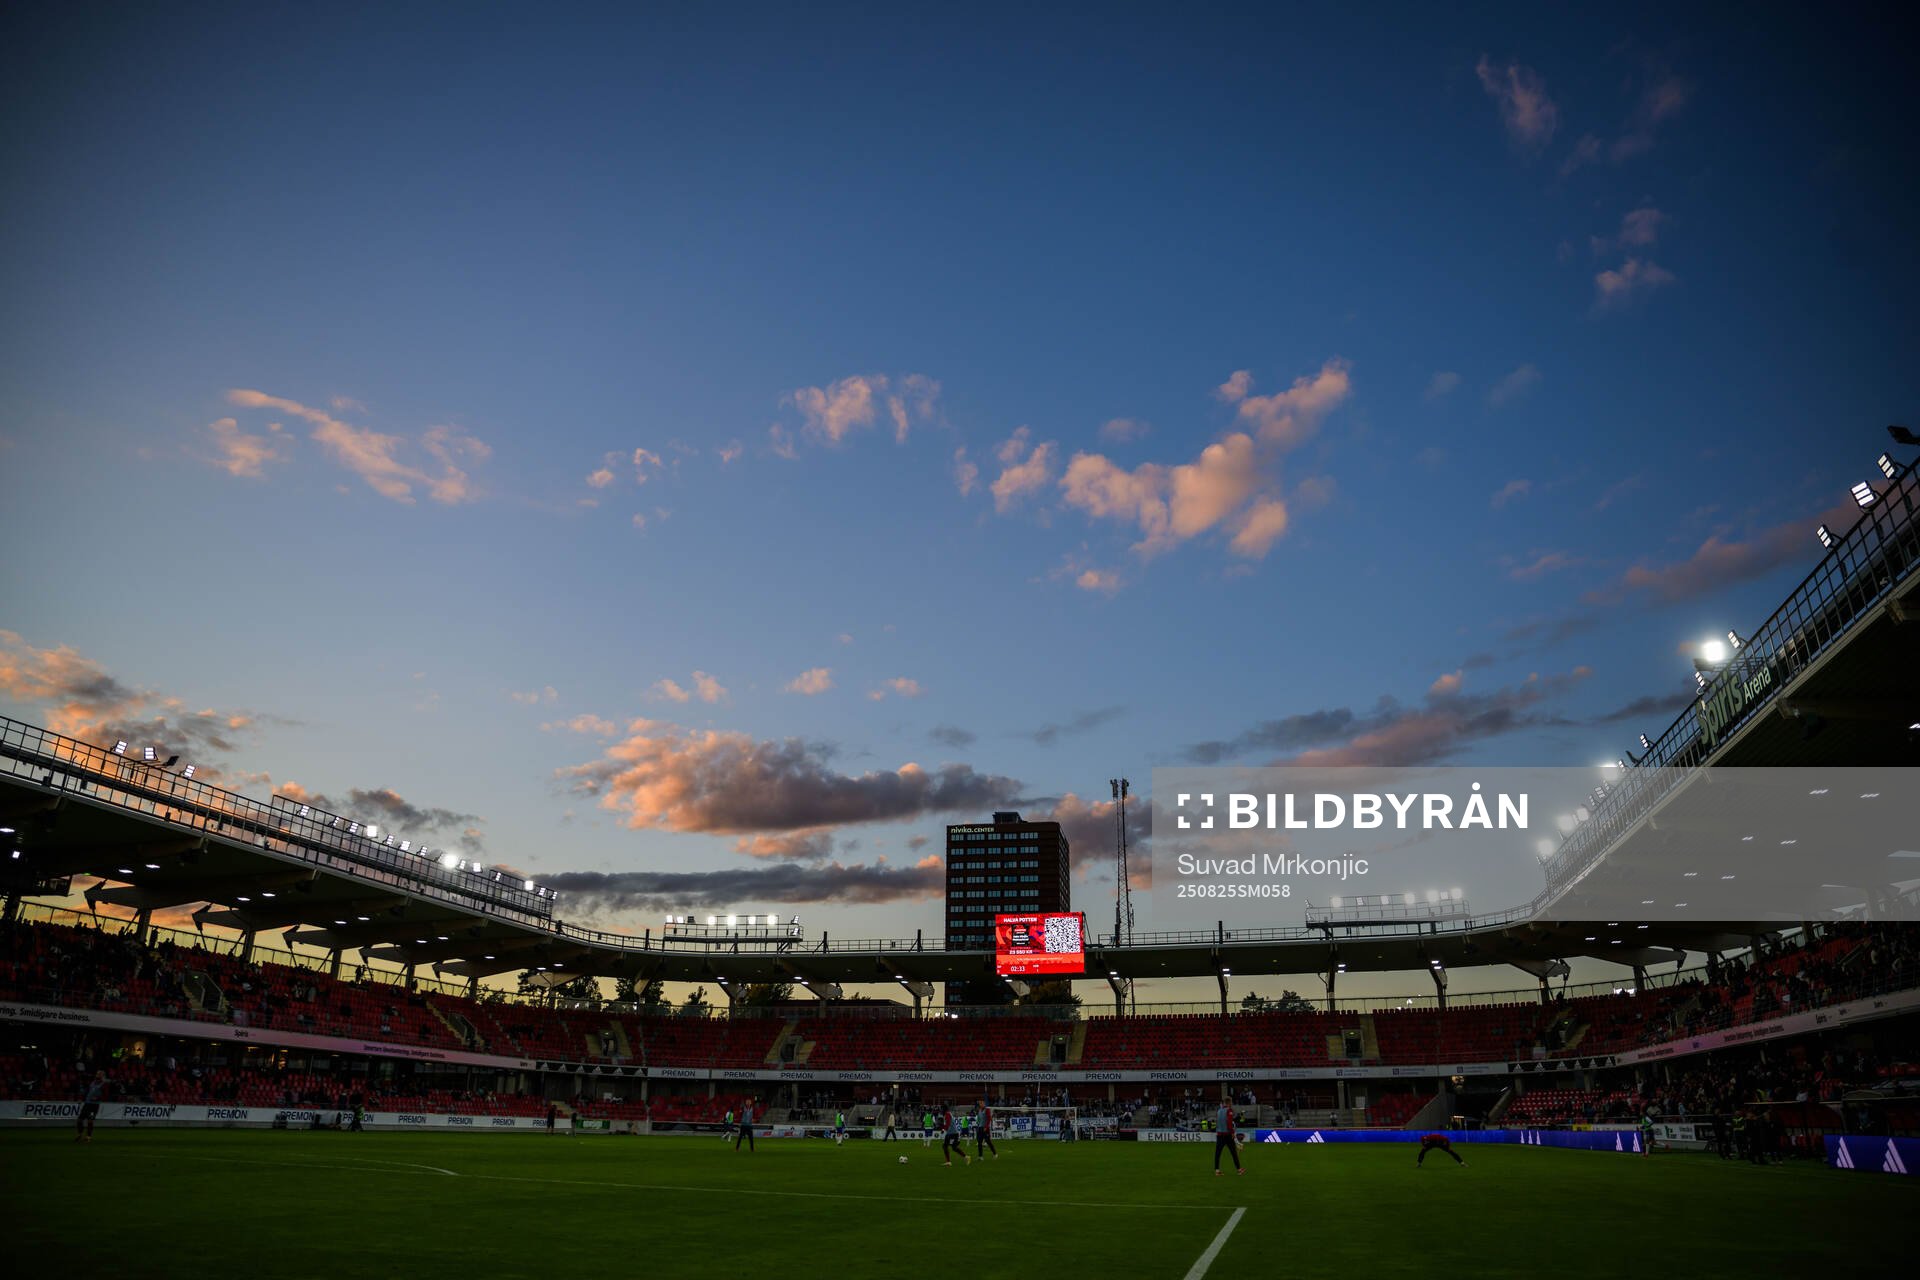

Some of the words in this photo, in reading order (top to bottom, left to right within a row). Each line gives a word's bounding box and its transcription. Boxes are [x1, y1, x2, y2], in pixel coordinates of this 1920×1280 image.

[1695, 670, 1742, 746] Spiris
[1743, 667, 1771, 704] Arena
[780, 1071, 813, 1079] PREMON
[839, 1072, 872, 1080] PREMON
[898, 1072, 932, 1080] PREMON
[959, 1073, 994, 1081] PREMON
[1022, 1073, 1057, 1081] PREMON
[1085, 1072, 1121, 1080] PREMON
[1217, 1071, 1254, 1079] PREMON
[25, 1104, 80, 1116] PREMON
[124, 1106, 171, 1117] PREMON
[208, 1109, 247, 1119] PREMON
[343, 1113, 374, 1123] PRON
[398, 1115, 426, 1124] PREMON
[448, 1117, 473, 1125] PREMON
[492, 1118, 515, 1126] PREMON
[1148, 1133, 1201, 1142] EMILSHUS
